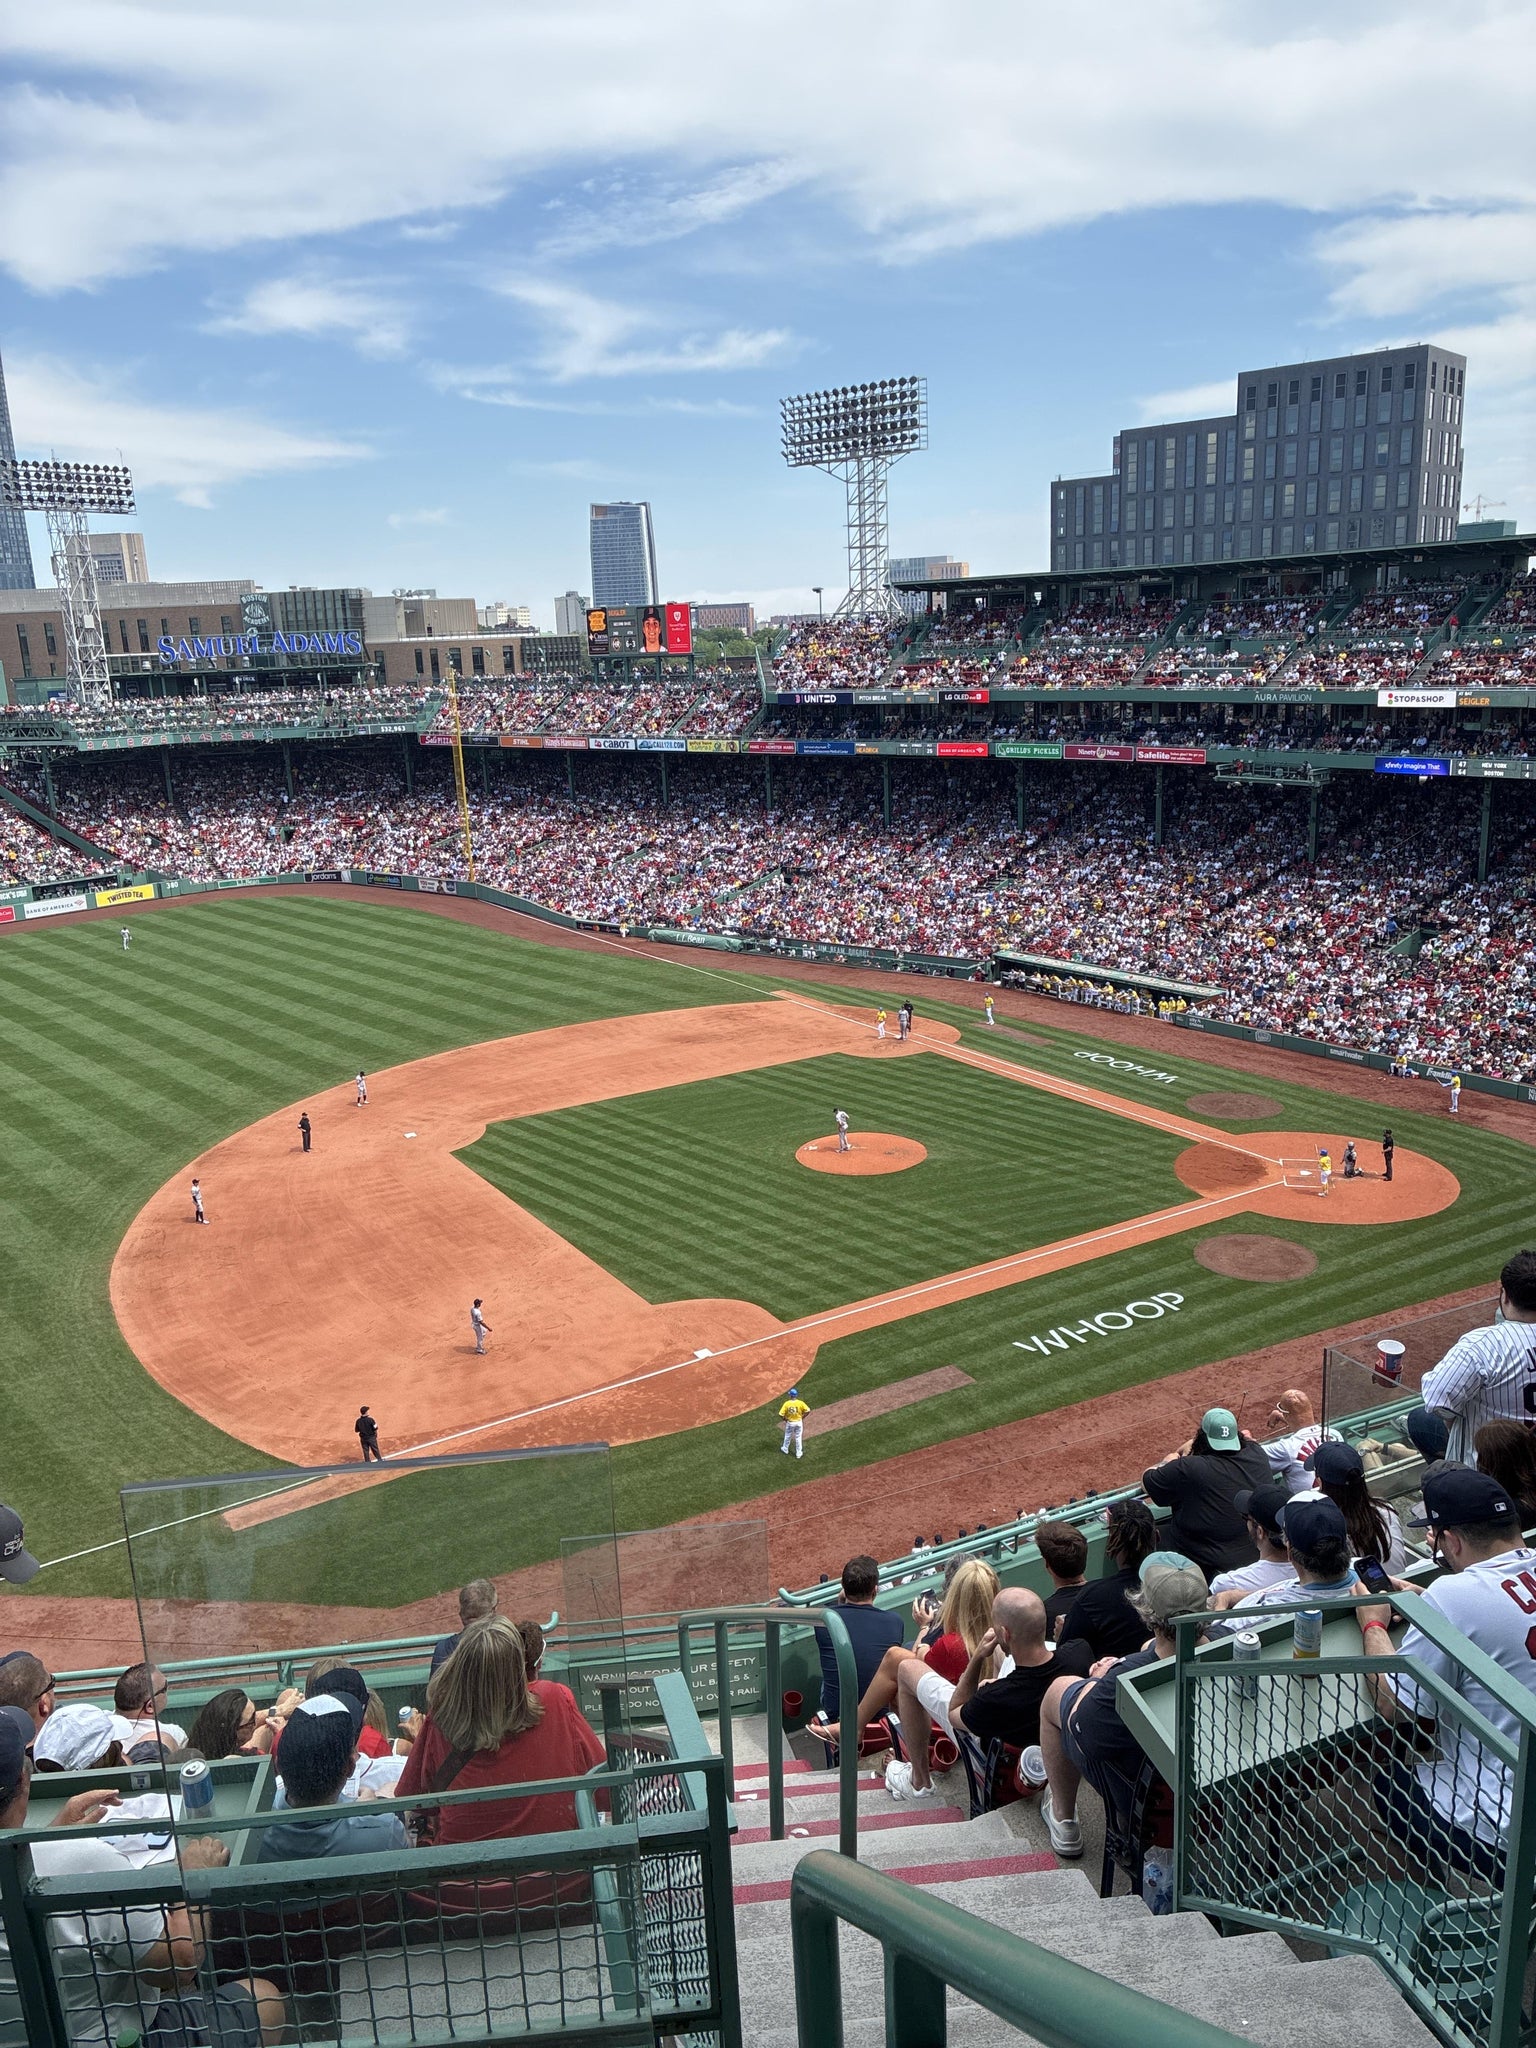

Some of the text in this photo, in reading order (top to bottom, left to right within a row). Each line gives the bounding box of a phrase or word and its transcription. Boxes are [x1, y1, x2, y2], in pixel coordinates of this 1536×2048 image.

[241, 594, 267, 604] BOSTON
[243, 615, 270, 625] ACADEMY
[157, 630, 362, 664] SAMUEL ADAMS
[804, 694, 837, 704] UNITED
[1280, 693, 1312, 702] PAVILION
[1458, 697, 1490, 706] SEIGLER
[141, 735, 154, 746] 27
[1033, 747, 1060, 755] PICKLES
[1077, 748, 1096, 756] Ninety
[1138, 751, 1170, 760] Safelite
[1403, 763, 1427, 771] Imagine
[107, 891, 132, 904] TWISTED
[50, 903, 74, 911] AMERICA
[1330, 1048, 1364, 1061] smartwater
[1073, 1051, 1179, 1084] WHOOP
[1012, 1292, 1185, 1356] WHOOP
[1220, 1426, 1230, 1437] B
[629, 1686, 650, 1694] OUT
[743, 1673, 750, 1681] &
[737, 1687, 760, 1696] RAIL
